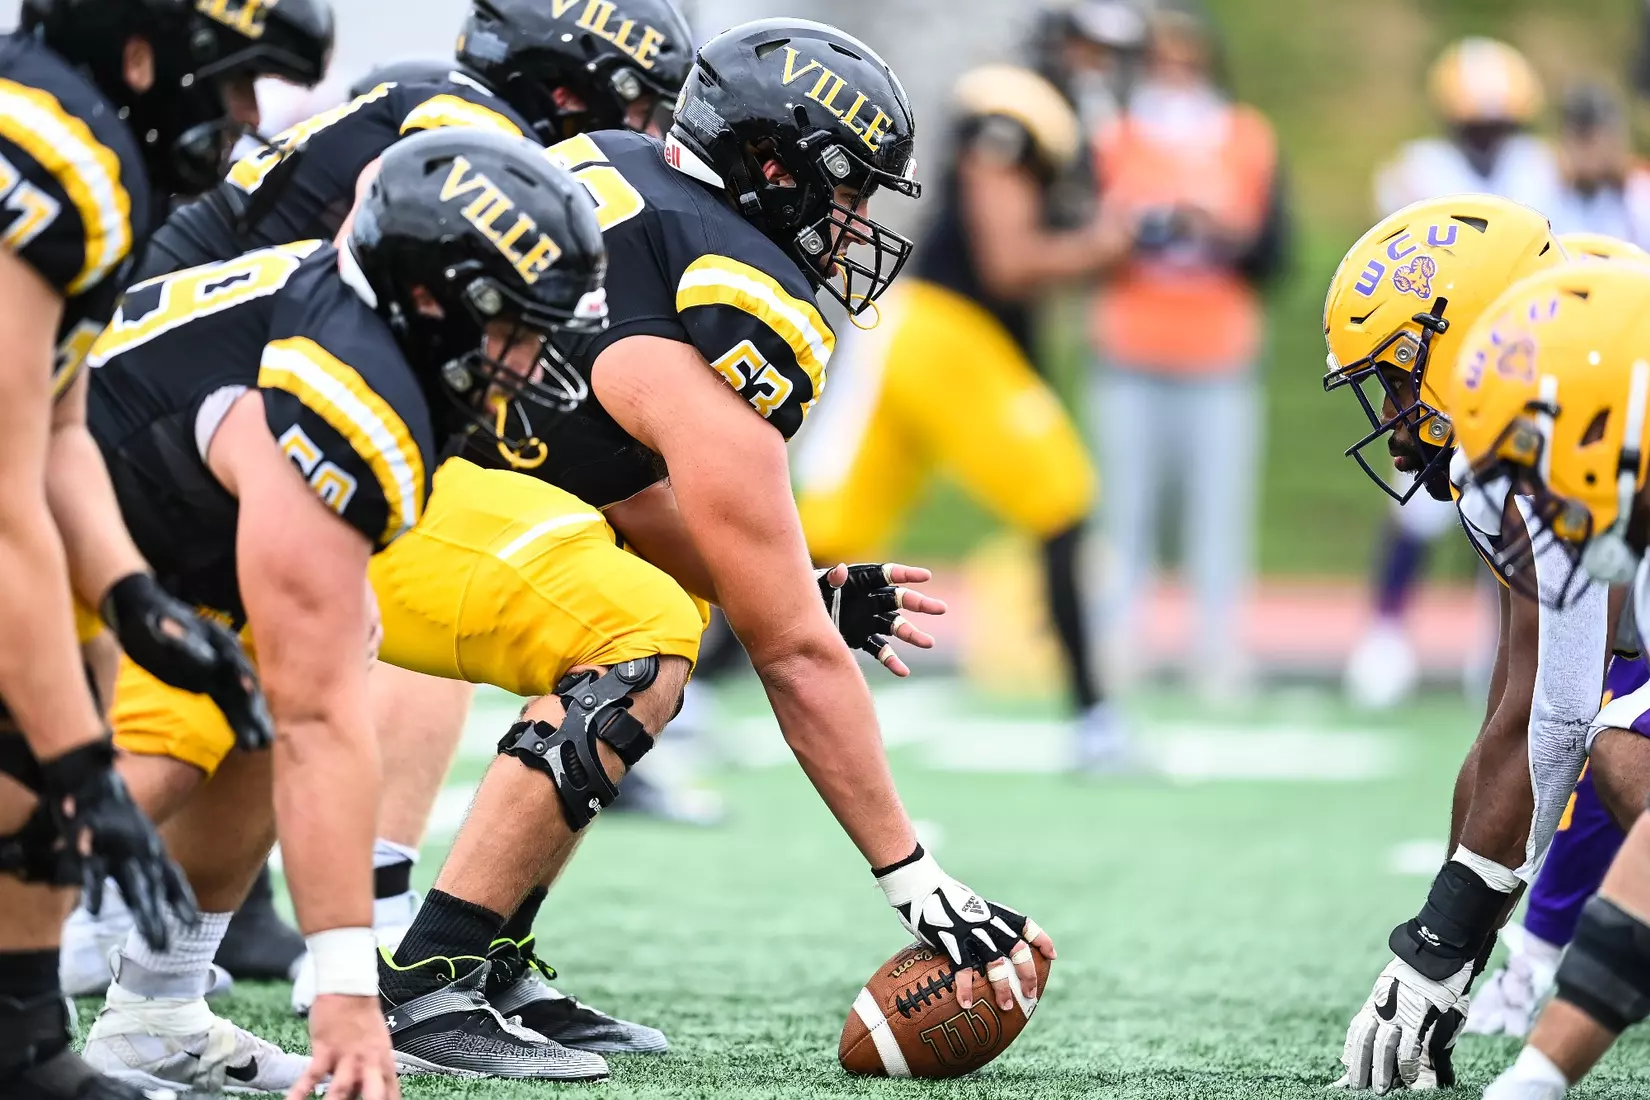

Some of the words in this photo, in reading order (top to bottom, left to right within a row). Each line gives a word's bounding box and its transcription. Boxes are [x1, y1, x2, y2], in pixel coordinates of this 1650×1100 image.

[781, 46, 893, 153] VILLE
[0, 152, 62, 250] 7
[439, 155, 563, 285] VILLE
[1354, 225, 1458, 297] WCU
